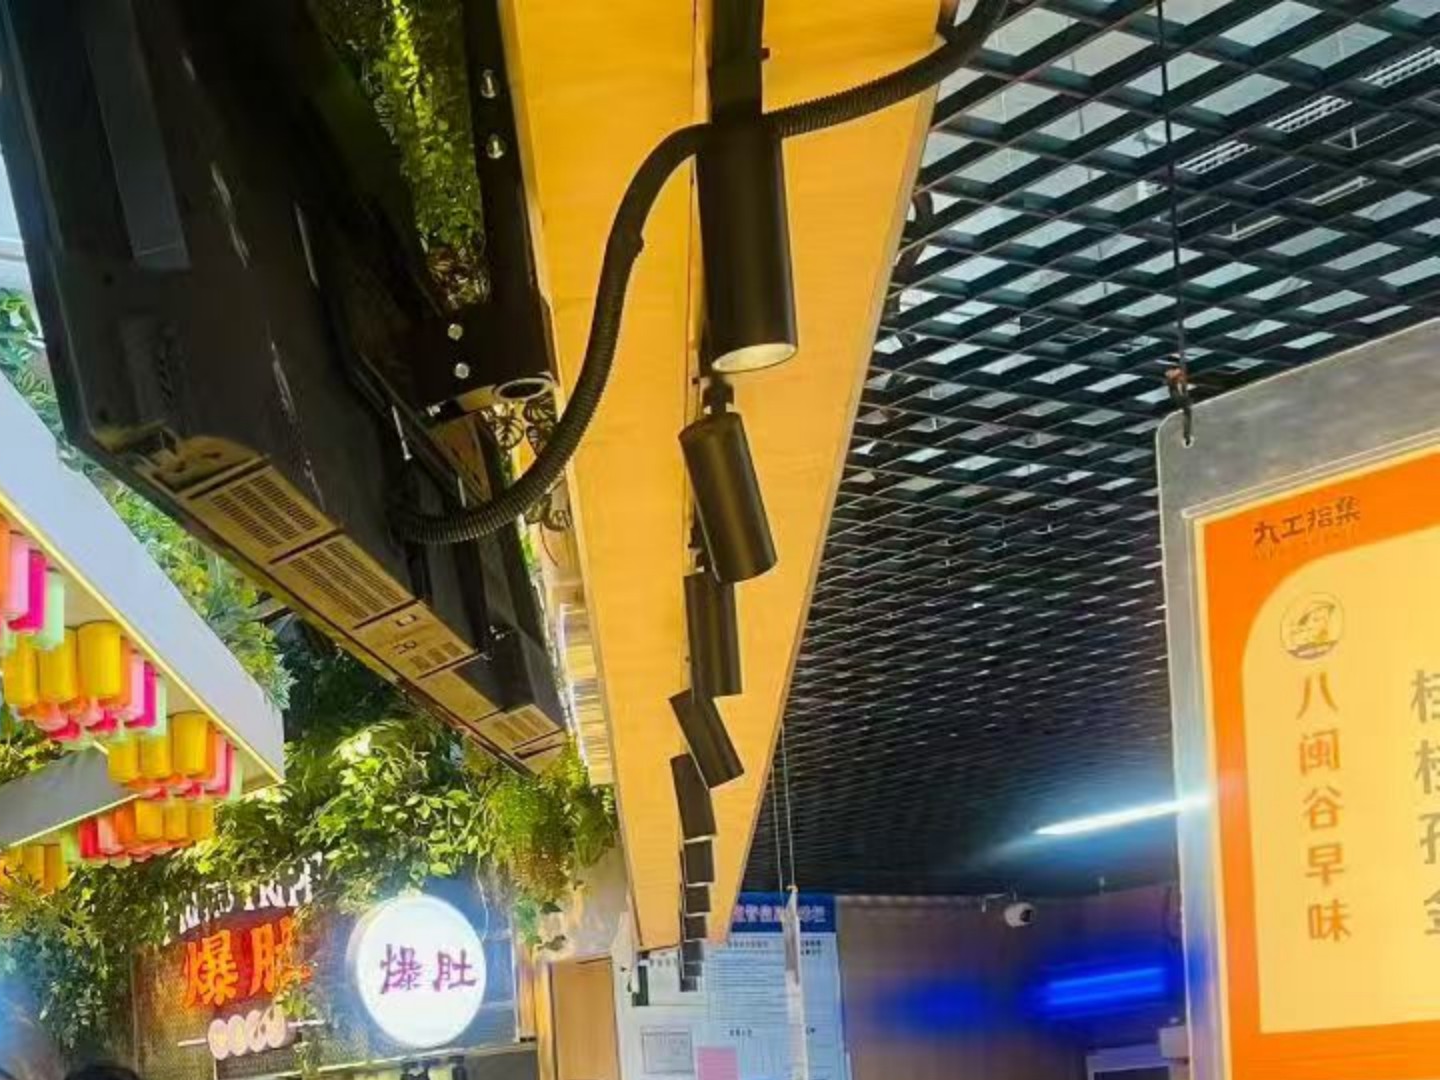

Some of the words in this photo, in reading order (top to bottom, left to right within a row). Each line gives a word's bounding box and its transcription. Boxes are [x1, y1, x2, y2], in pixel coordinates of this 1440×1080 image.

[1295, 671, 1351, 943] 八闽谷早味
[379, 943, 479, 995] 爆肚
